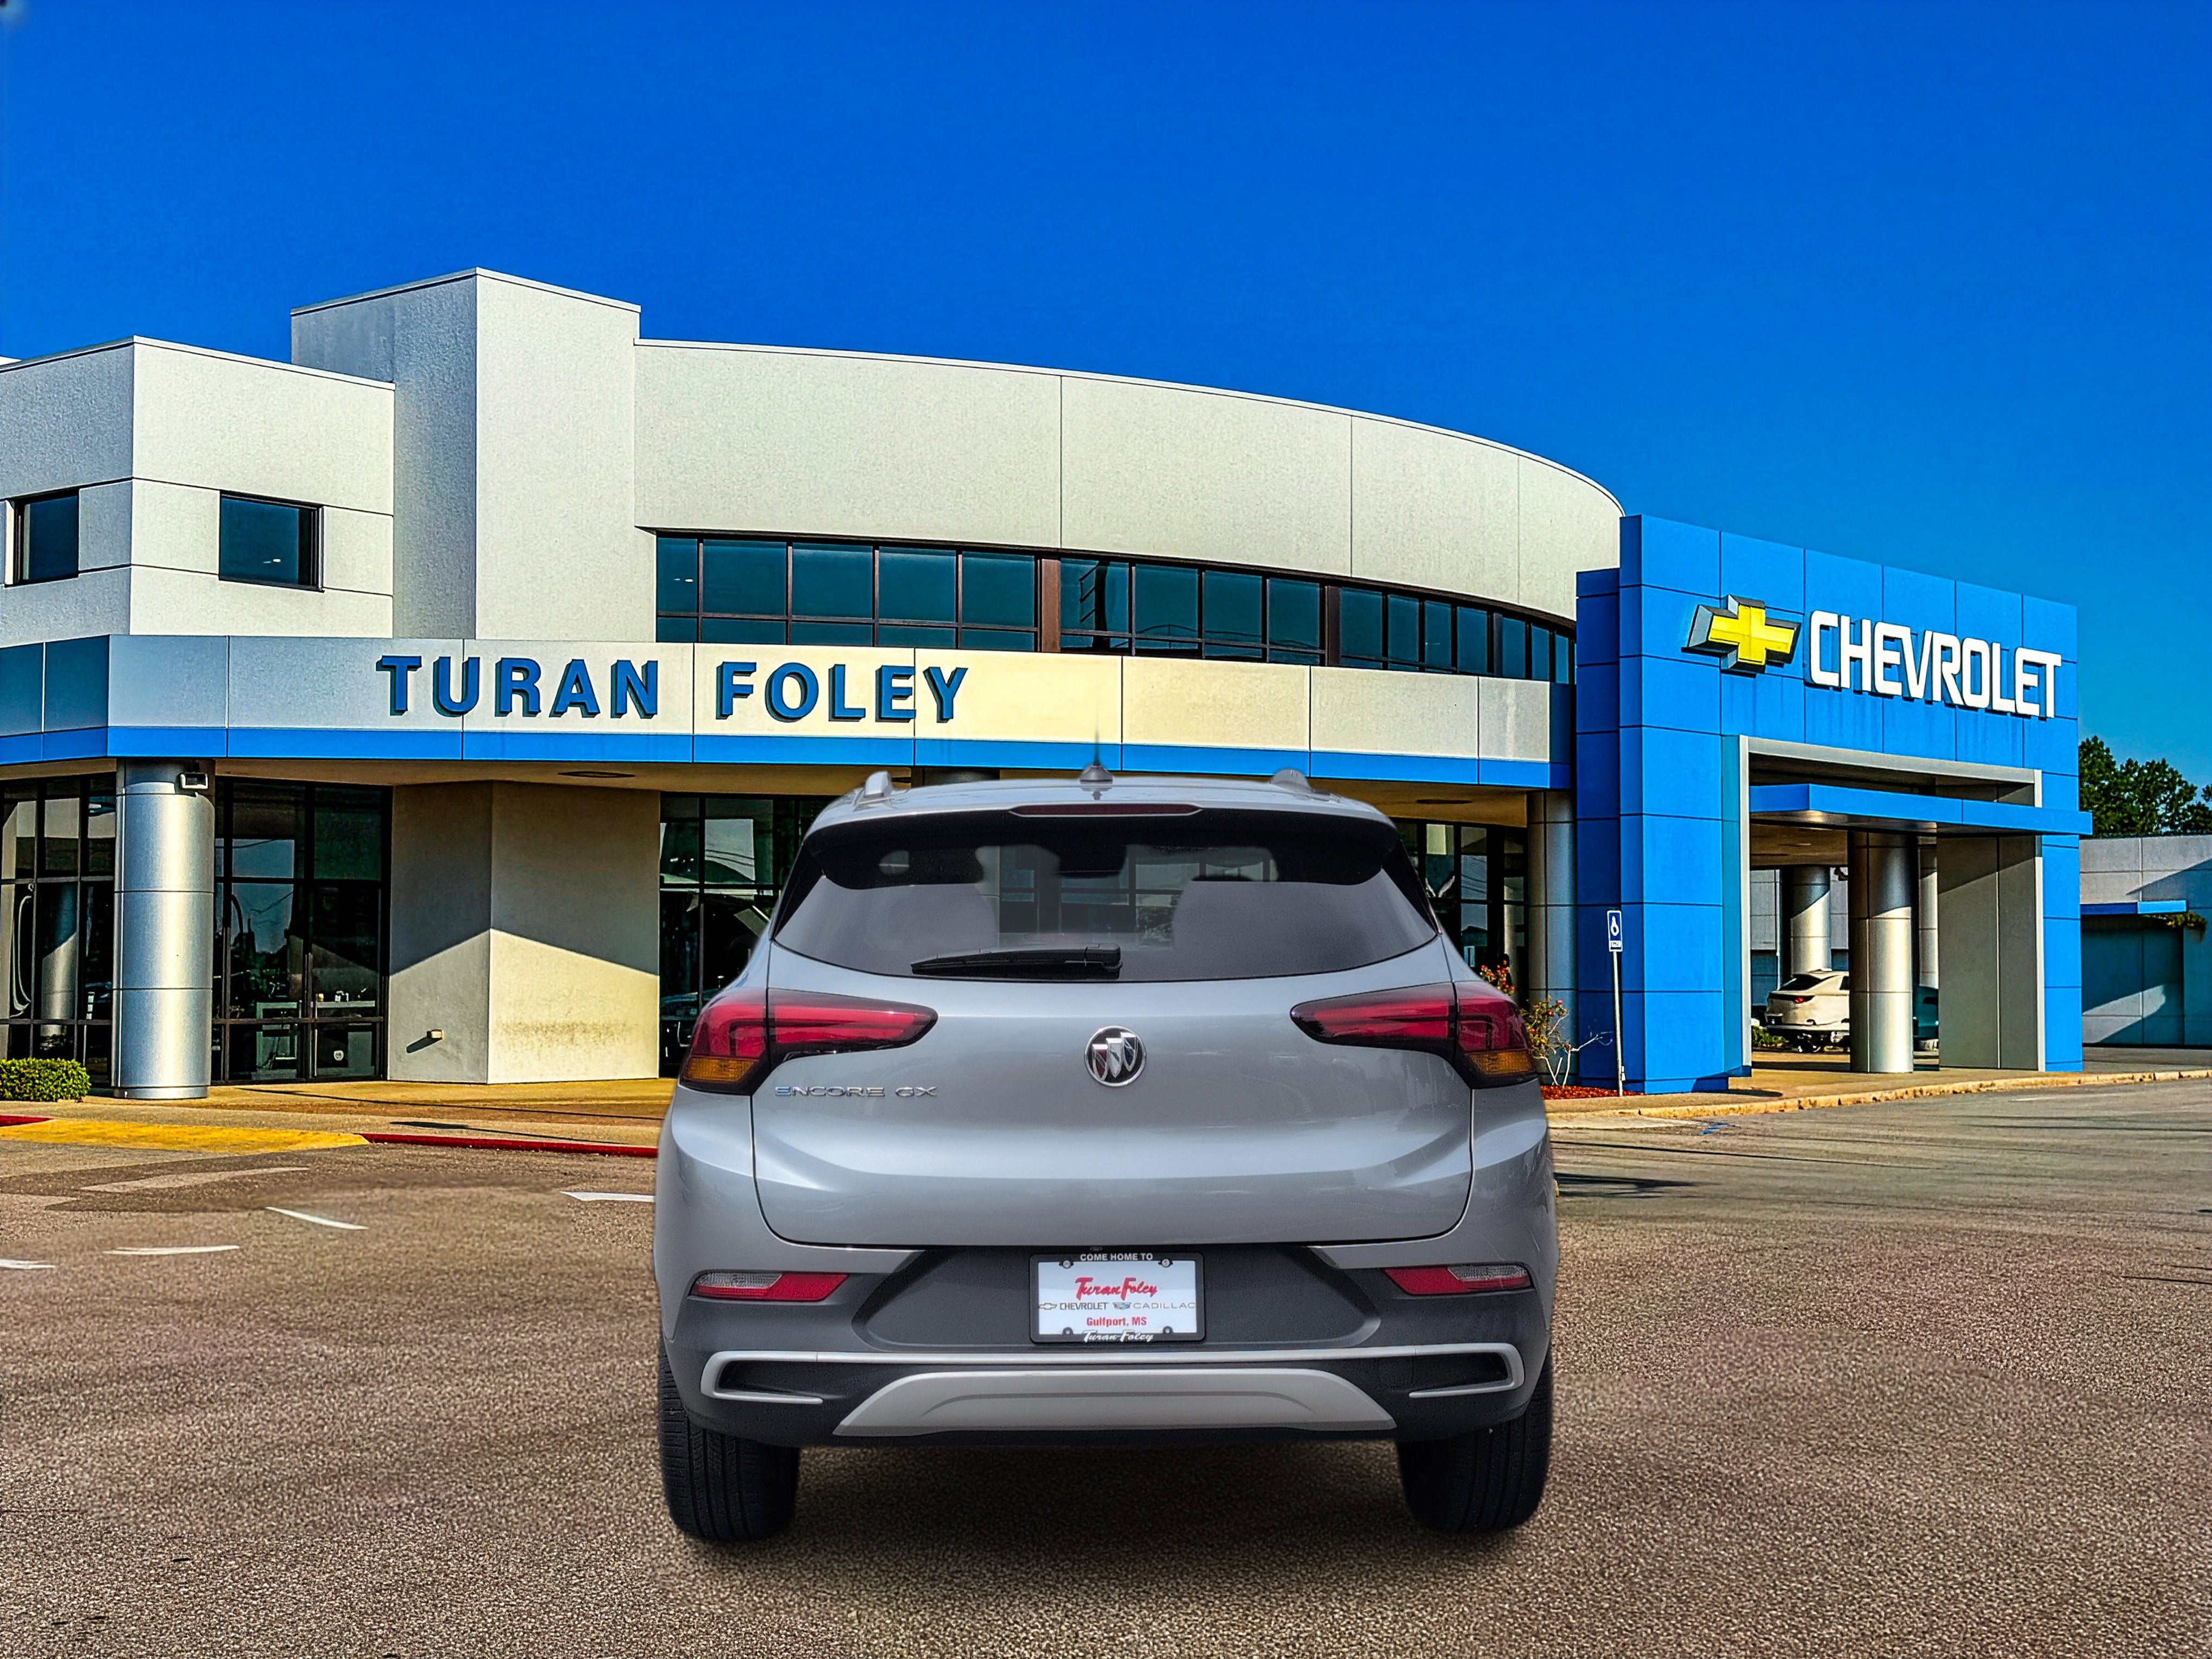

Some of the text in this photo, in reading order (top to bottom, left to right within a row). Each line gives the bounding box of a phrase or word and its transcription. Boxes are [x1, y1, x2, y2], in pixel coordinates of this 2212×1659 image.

[1808, 610, 2062, 719] CHEVROLET
[376, 655, 969, 723] TURAN FOLEY
[775, 1086, 937, 1097] ENCORE GX
[1080, 1253, 1108, 1261] COME
[1075, 1277, 1158, 1301] Turan Foley
[1059, 1302, 1108, 1310] CHEVROLET
[1086, 1317, 1147, 1327] Gulfport, MS
[1083, 1329, 1154, 1342] Turan Foley
